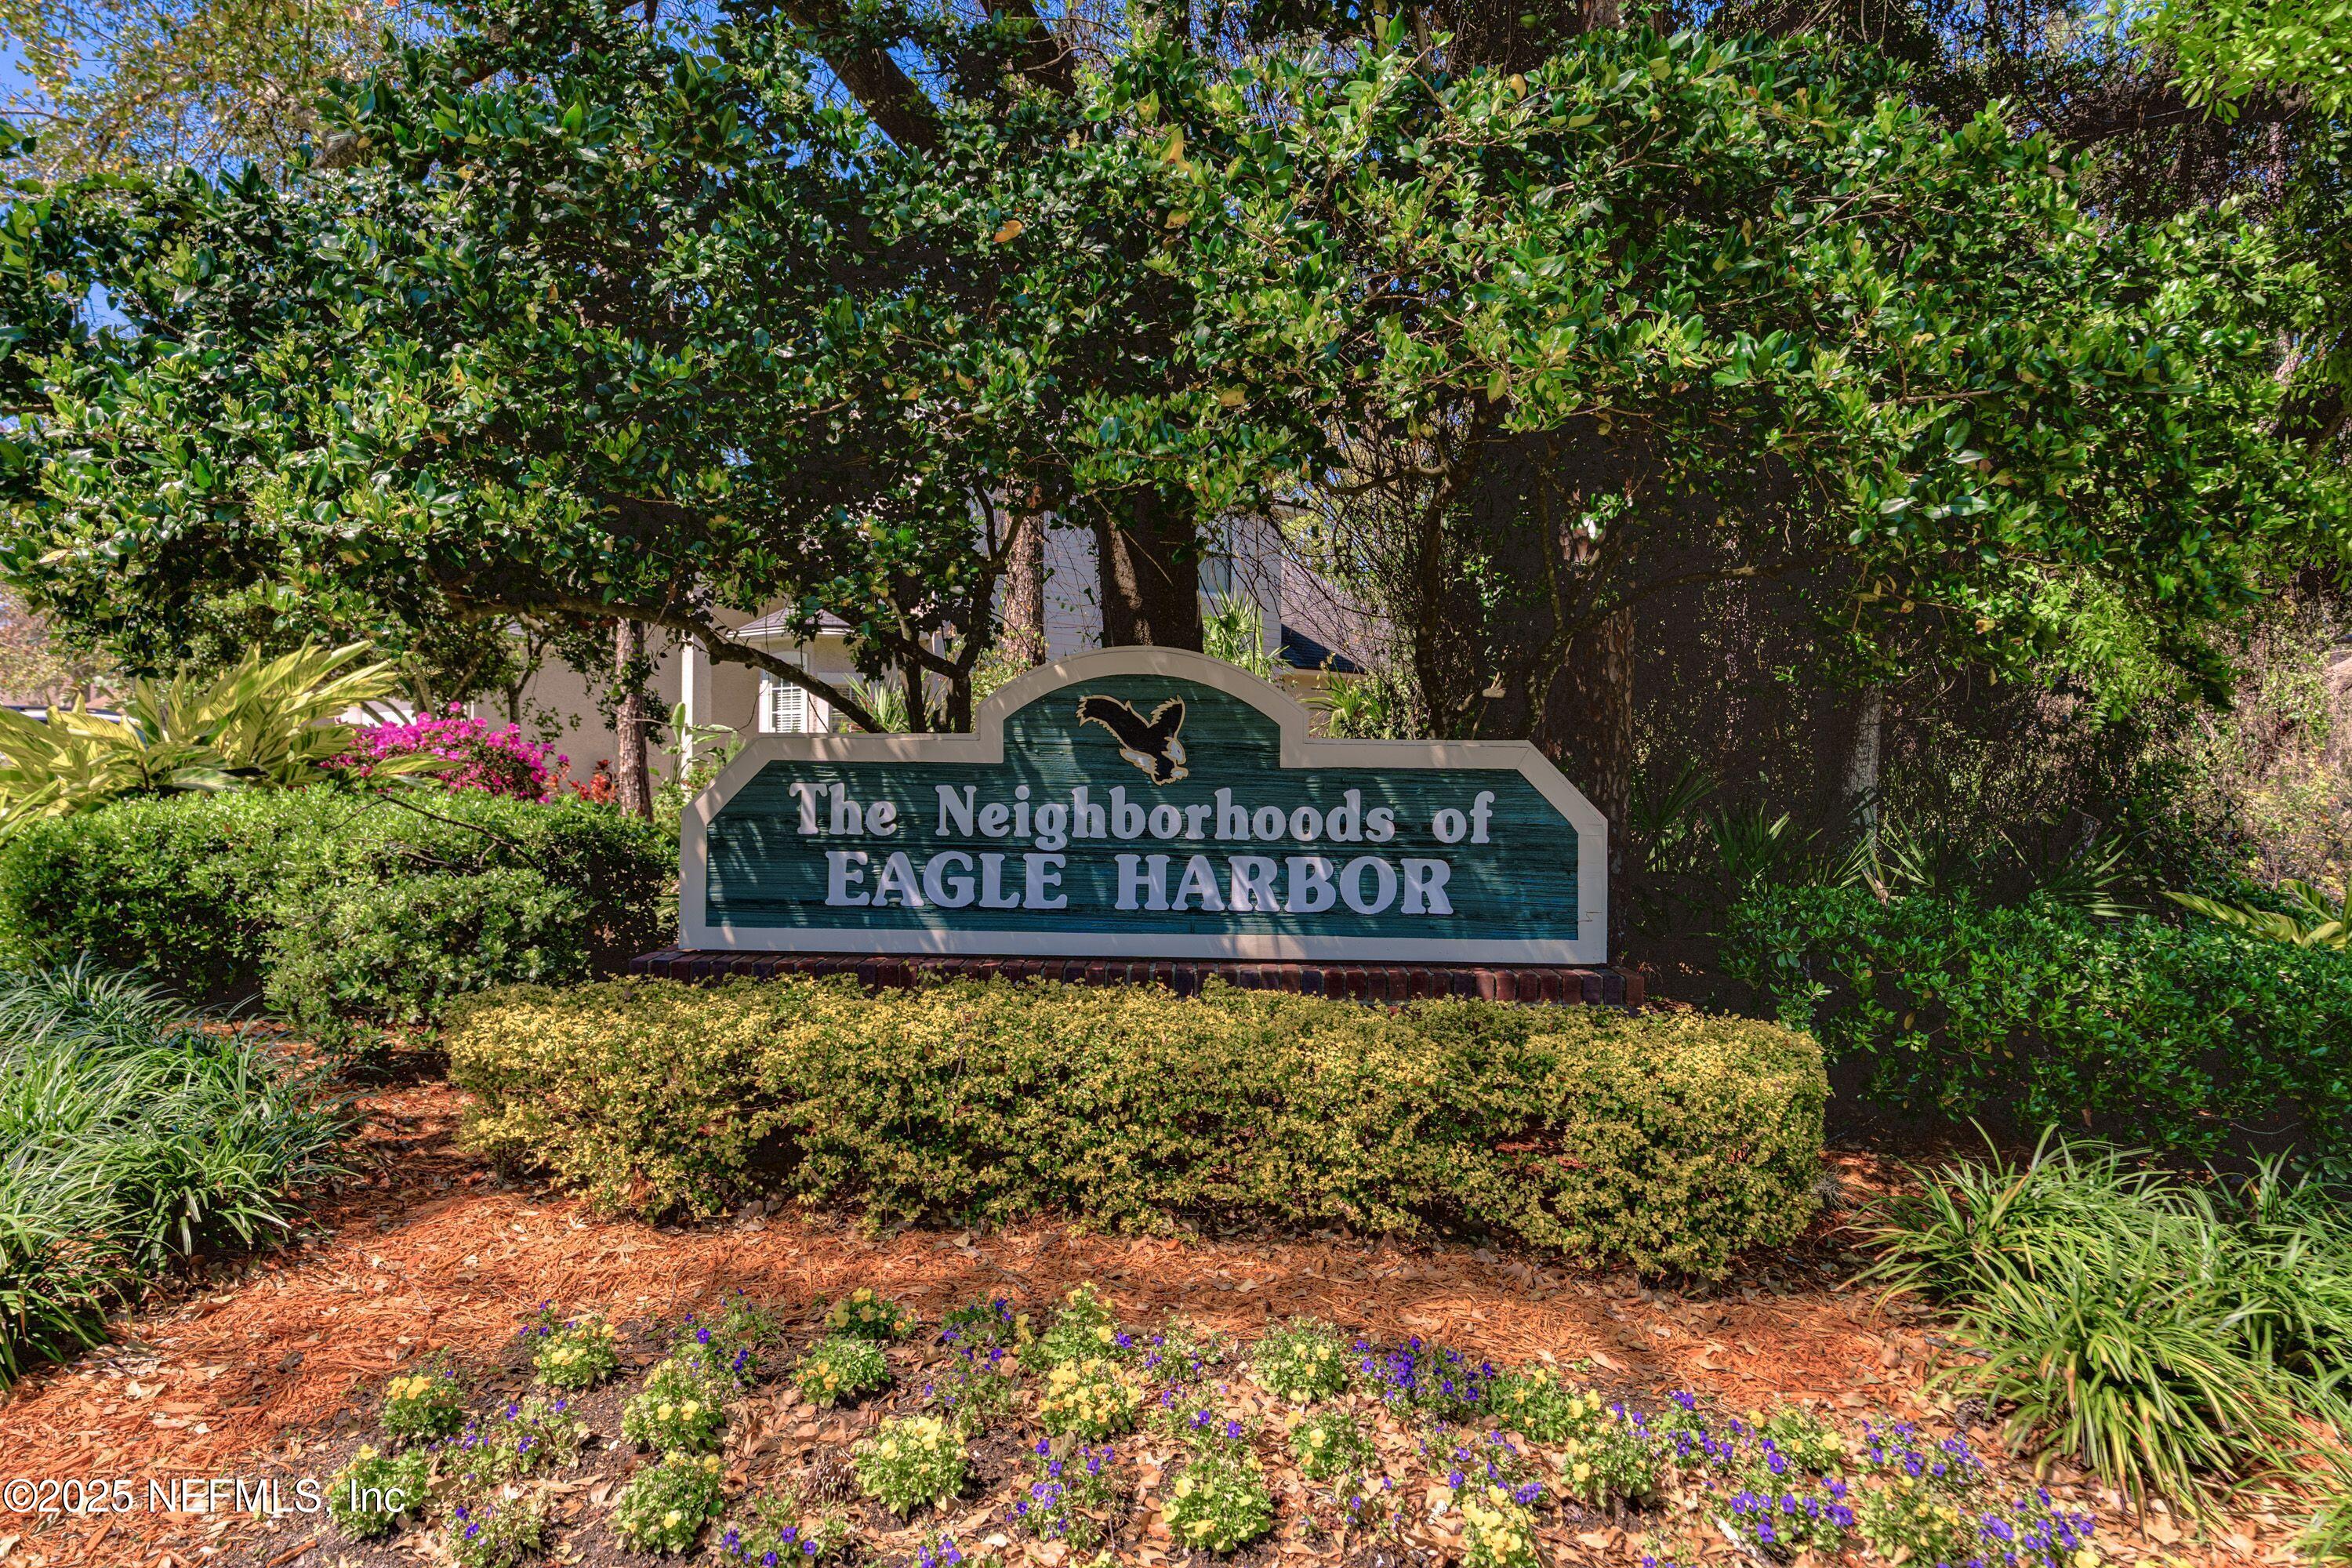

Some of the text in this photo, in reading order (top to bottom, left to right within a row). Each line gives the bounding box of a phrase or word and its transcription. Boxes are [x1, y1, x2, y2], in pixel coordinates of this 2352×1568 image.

[789, 782, 1495, 850] The Neighborhoods of
[825, 850, 1454, 915] EAGLE HARBOR
